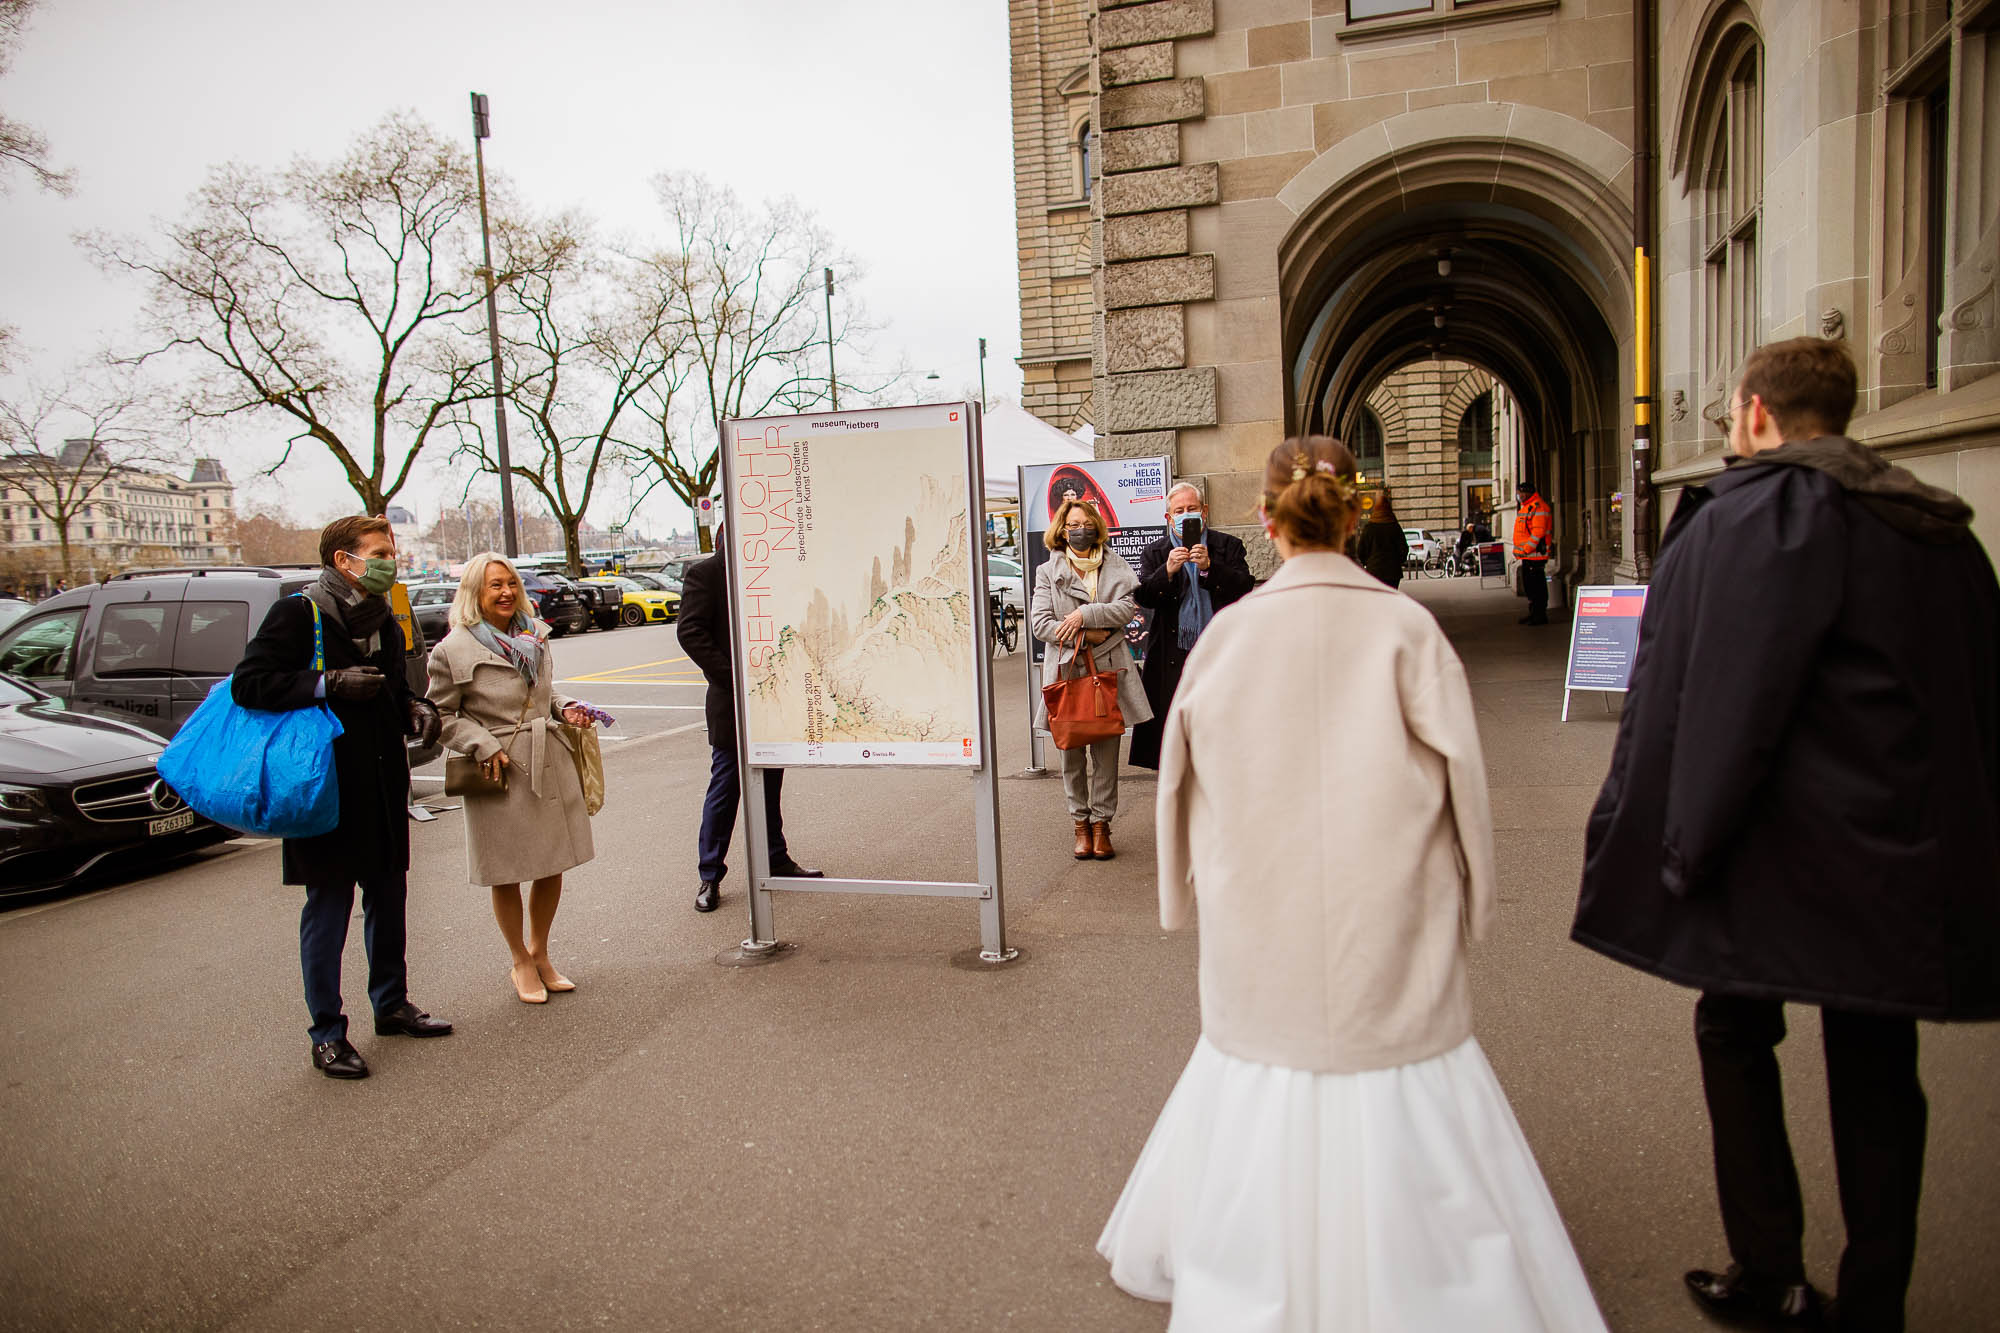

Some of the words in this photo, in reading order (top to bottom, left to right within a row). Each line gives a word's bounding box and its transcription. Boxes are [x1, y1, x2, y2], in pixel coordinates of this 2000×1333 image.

[801, 440, 810, 472] Chinas
[793, 441, 803, 504] Landschaften
[1118, 477, 1161, 487] SCHNEIDER
[1135, 468, 1161, 477] HELGA
[765, 425, 797, 550] NATUR
[803, 475, 811, 502] Kunst
[804, 504, 813, 521] der
[796, 506, 807, 562] Sprechende
[805, 523, 813, 531] in
[737, 428, 775, 671] SEHNSUCHT
[804, 672, 813, 695] 2020
[813, 685, 822, 706] 2021
[806, 697, 816, 746] September
[815, 709, 824, 739] Januar
